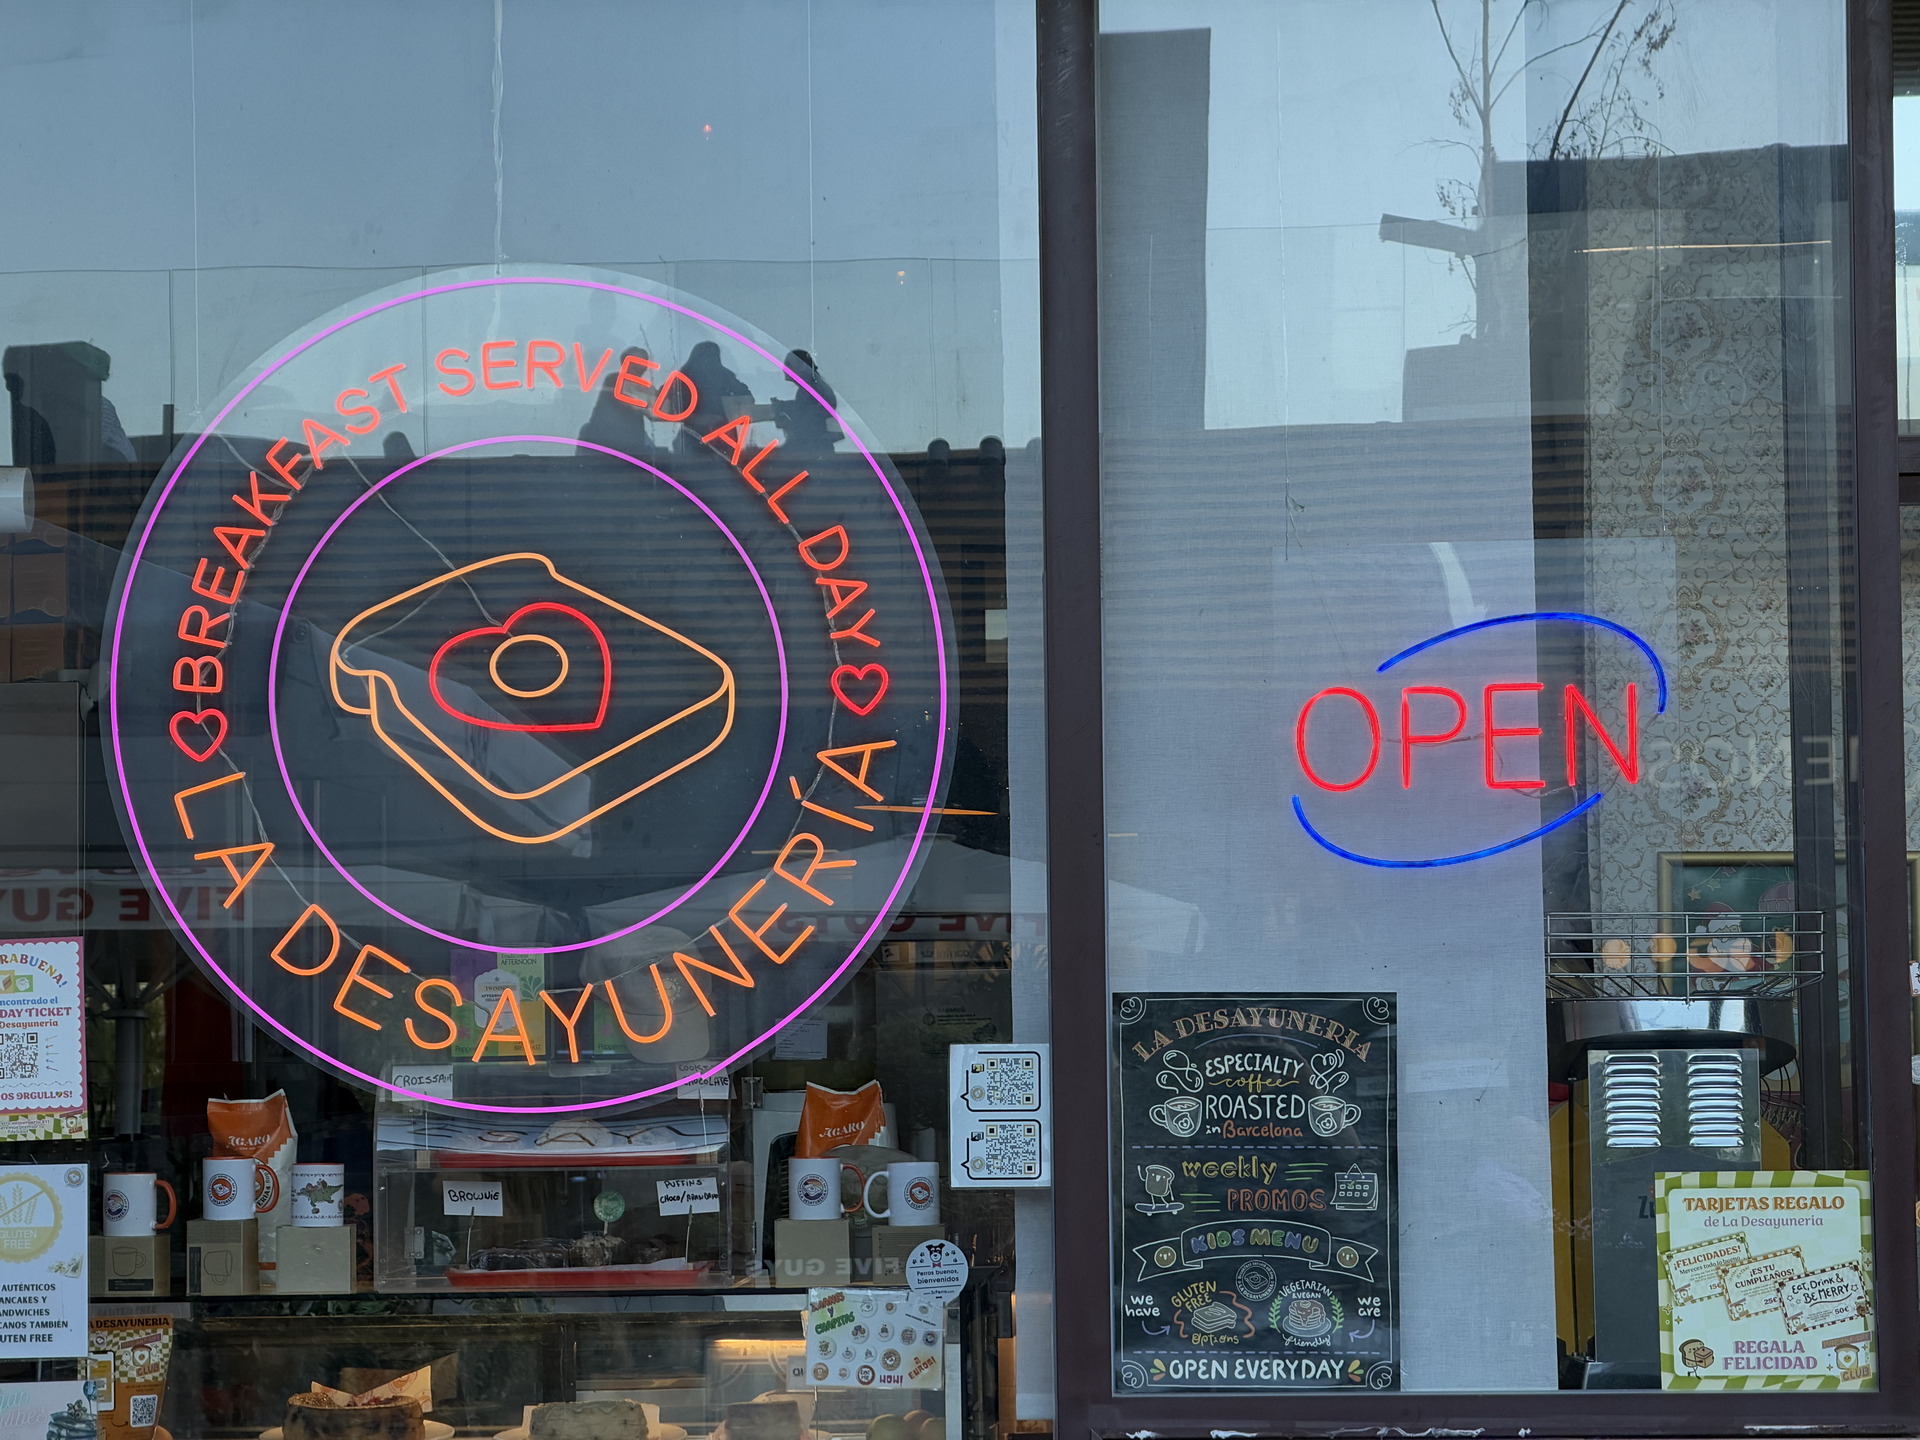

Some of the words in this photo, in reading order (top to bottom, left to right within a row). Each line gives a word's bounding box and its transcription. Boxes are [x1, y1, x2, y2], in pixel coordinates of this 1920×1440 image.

[172, 363, 407, 694] BREAKFAST
[435, 340, 698, 422] SERVED
[701, 414, 810, 525] ALL
[797, 524, 881, 648] DAY
[1296, 682, 1639, 793] OPEN
[173, 770, 276, 910] LA
[269, 739, 898, 1067] DESAYUNERÍA
[49, 996, 58, 1004] el
[25, 1006, 72, 1017] TICKET
[1131, 1029, 1173, 1063] LA
[1172, 1007, 1372, 1063] DESAYUNERIA
[1205, 1053, 1305, 1078] ESPECIALTY
[1209, 1074, 1300, 1093] coffee
[1205, 1095, 1306, 1120] ROASTED
[1205, 1124, 1221, 1135] in
[1222, 1120, 1303, 1138] Barcelona
[1181, 1155, 1279, 1186] weekly
[1227, 1188, 1327, 1212] PROMOS
[1683, 1196, 1770, 1214] TARJETAS
[1773, 1195, 1846, 1211] REGALO
[1703, 1215, 1720, 1227] de
[1722, 1215, 1738, 1227] La
[3, 1239, 32, 1250] FREE
[1190, 1229, 1246, 1254] KIDS
[1250, 1228, 1320, 1254] MENU
[1765, 1264, 1775, 1273] TU
[917, 1276, 960, 1285] bienvenidos
[1835, 1273, 1844, 1283] &
[2, 1281, 56, 1292] AUTÉNTICOS
[1281, 1280, 1333, 1298] VEGETARIAN
[41, 1296, 48, 1304] Y
[1130, 1294, 1154, 1306] we
[1171, 1280, 1218, 1309] GLUTEN
[1803, 1291, 1817, 1304] BE
[1817, 1284, 1850, 1300] MERRY
[1185, 1293, 1213, 1313] FREE
[1357, 1296, 1382, 1307] we
[1125, 1305, 1161, 1317] have
[1358, 1307, 1382, 1318] are
[1834, 1306, 1850, 1315] 50€
[30, 1318, 68, 1328] TAMBIÉN
[96, 1317, 169, 1329] DESAYUNERIA
[30, 1334, 53, 1343] FREE
[1734, 1340, 1806, 1354] REGALA
[137, 1364, 160, 1376] CLUB
[1169, 1359, 1228, 1380] OPEN
[1723, 1356, 1818, 1370] FELICIDAD
[1842, 1366, 1870, 1381] CLUB
